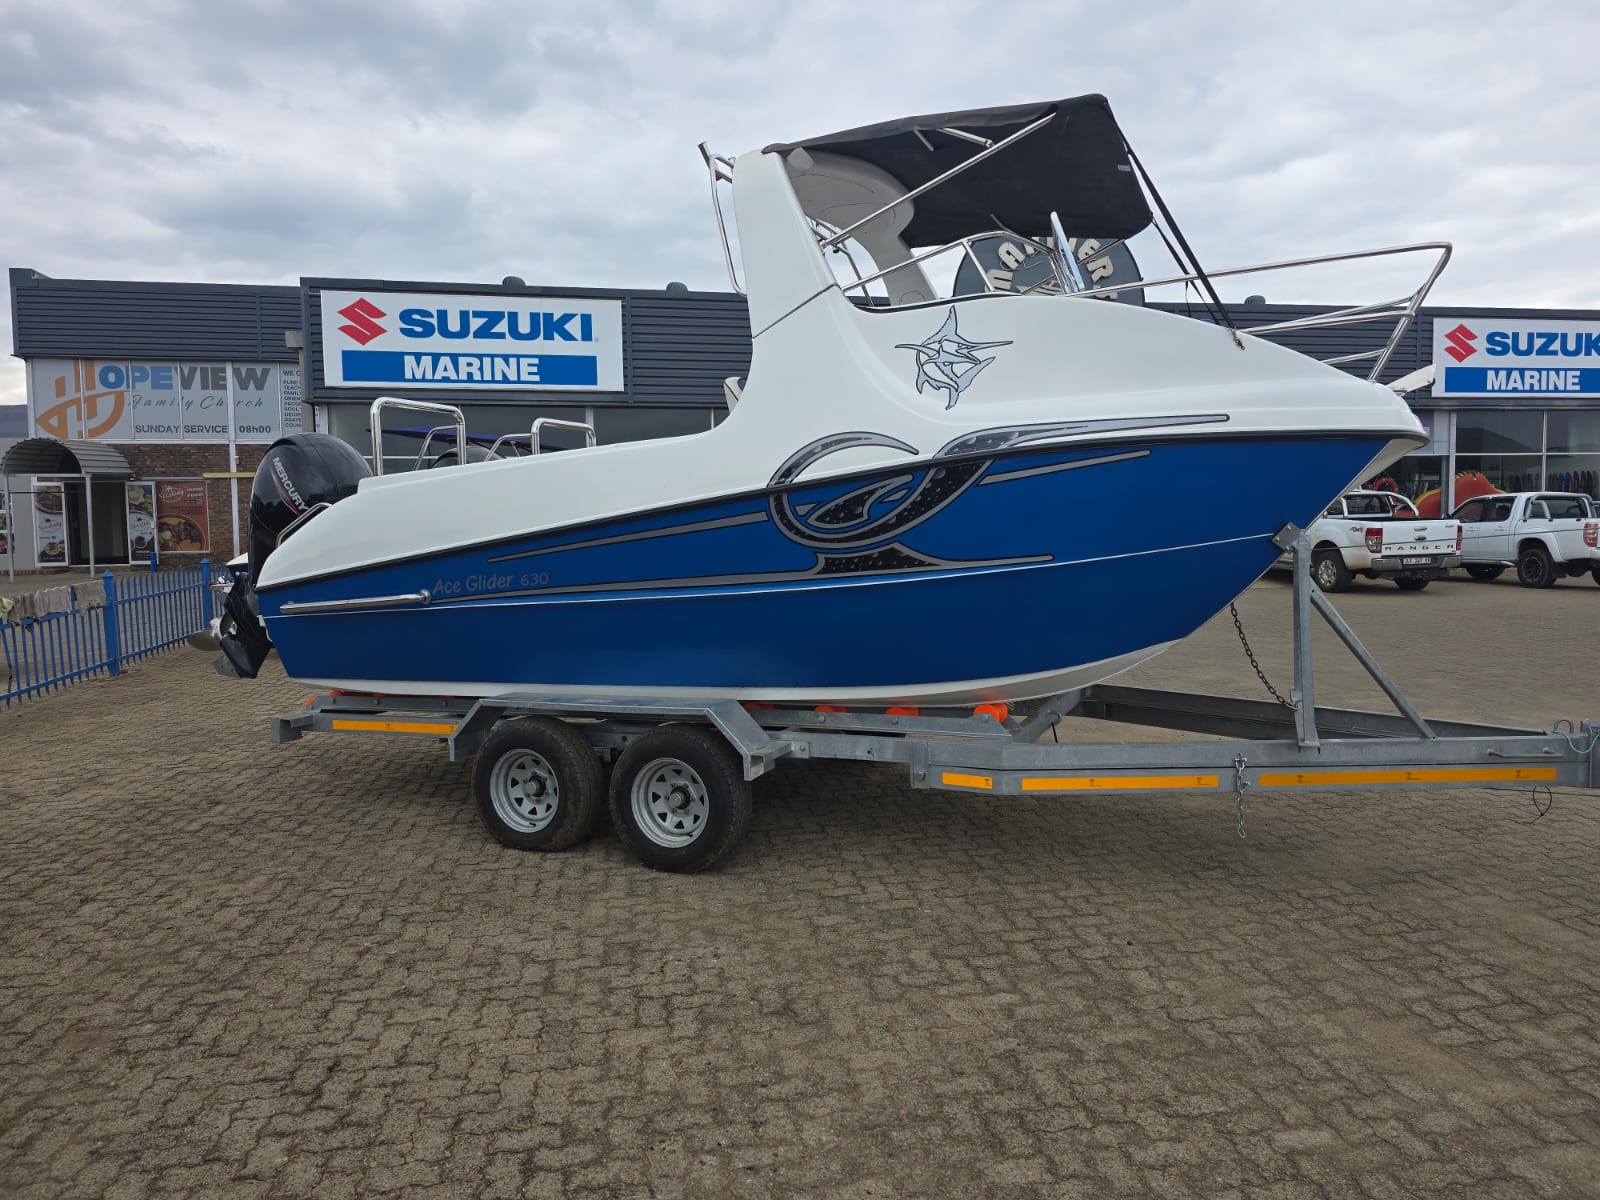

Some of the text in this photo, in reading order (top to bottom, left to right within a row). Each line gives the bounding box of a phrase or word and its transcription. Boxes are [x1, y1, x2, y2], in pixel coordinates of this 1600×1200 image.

[399, 308, 593, 342] SUZUKI
[404, 355, 540, 382] MARINE
[1486, 370, 1581, 391] MARINE
[199, 395, 264, 410] Chrch
[135, 424, 271, 434] SUNDAY SERVICE 08h00
[272, 457, 310, 510] MERCURY
[433, 572, 549, 595] Ace Glider 630
